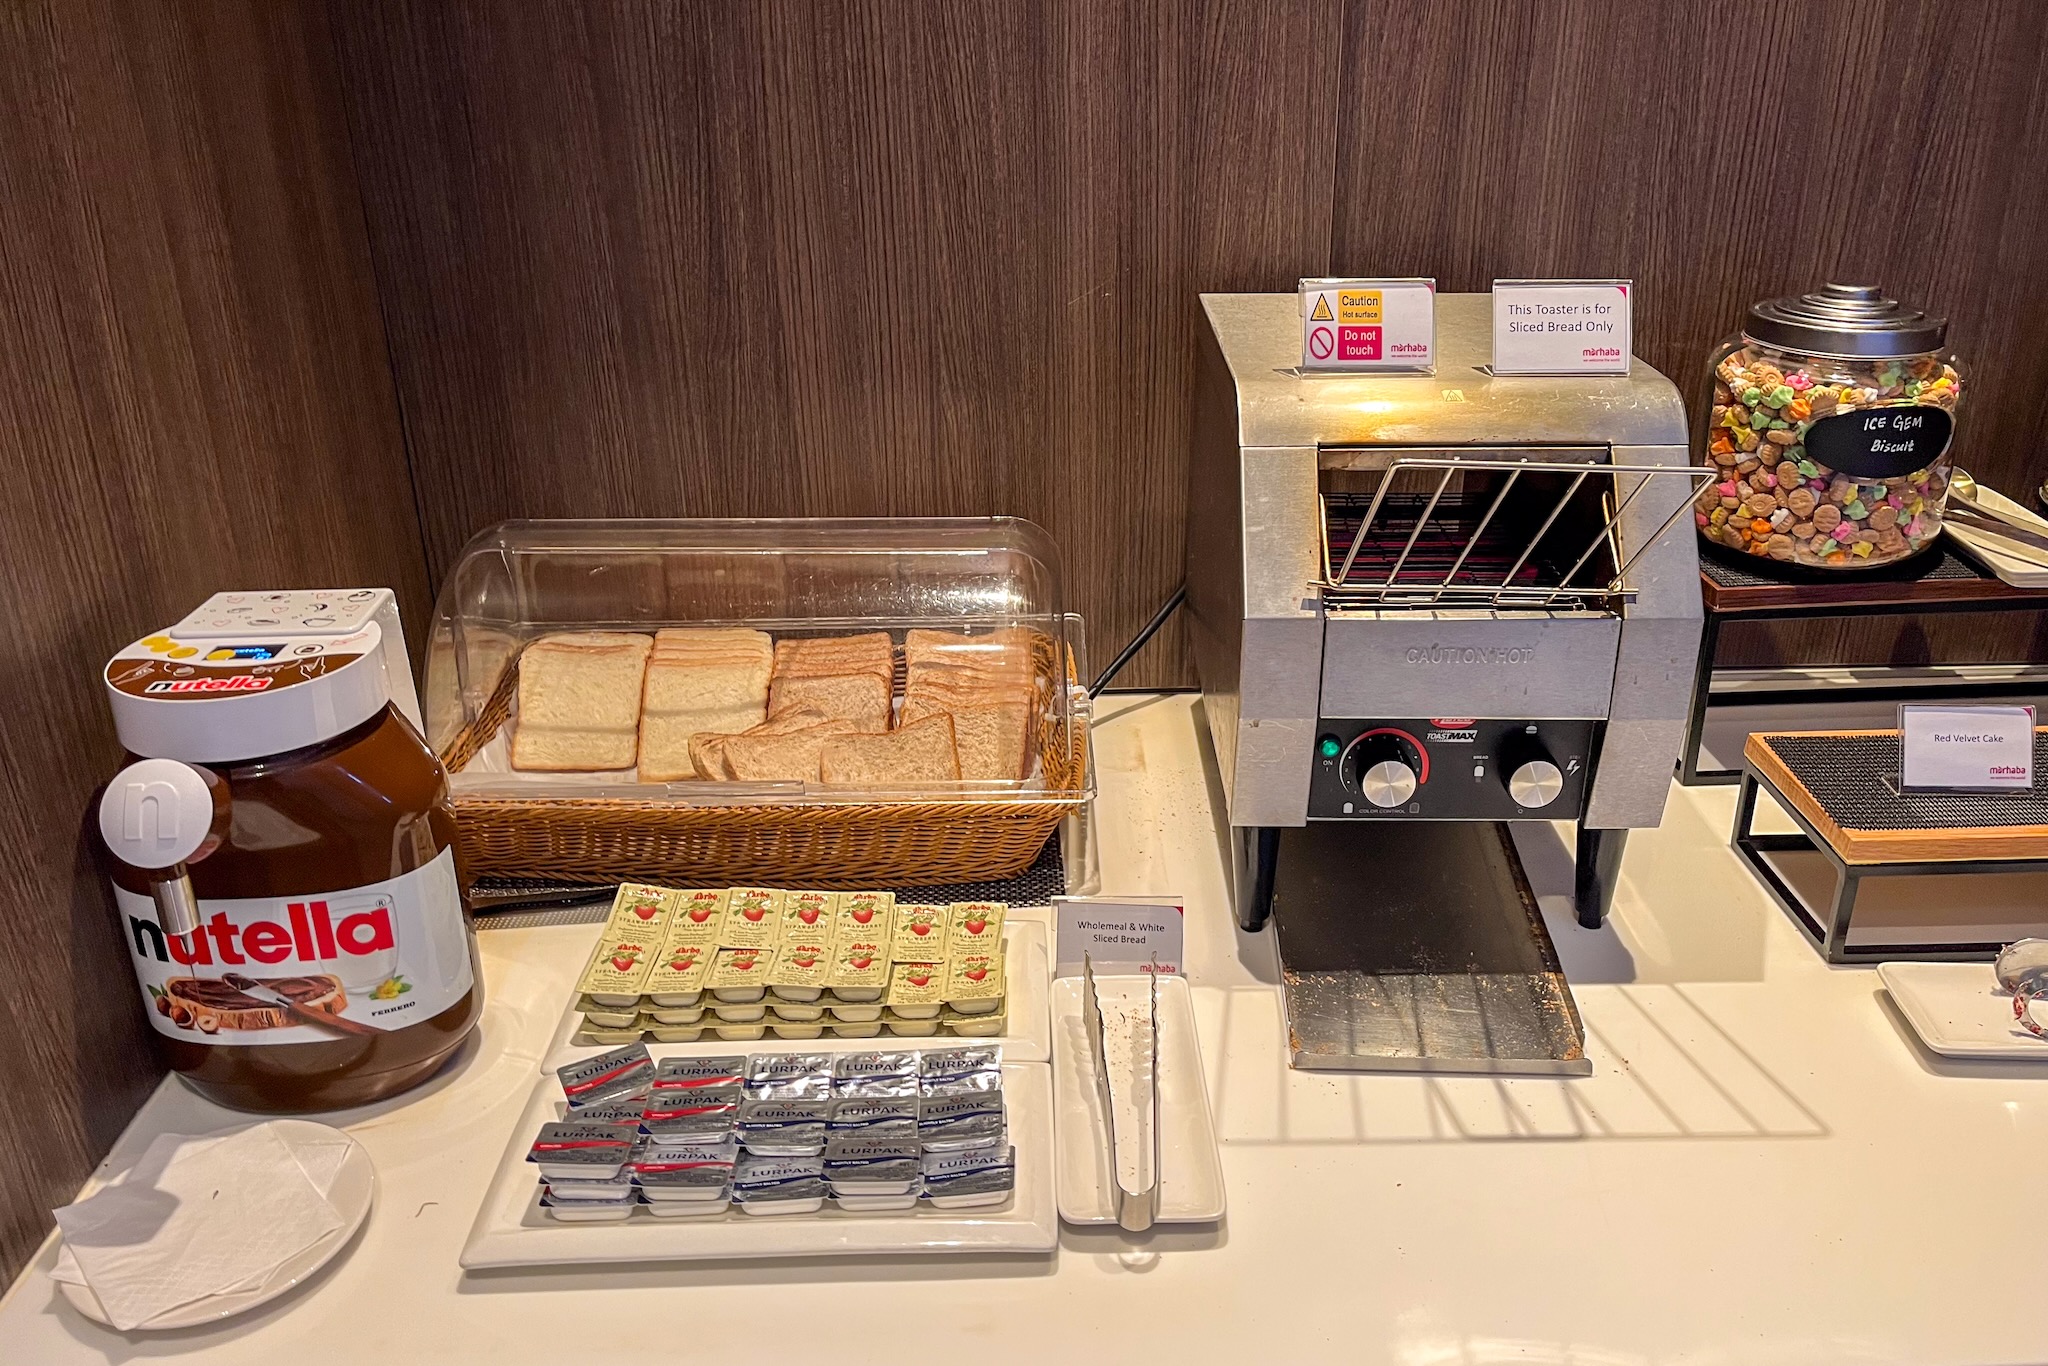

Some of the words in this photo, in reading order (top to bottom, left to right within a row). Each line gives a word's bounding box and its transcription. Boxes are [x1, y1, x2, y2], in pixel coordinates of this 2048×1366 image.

[1341, 295, 1379, 306] Caution
[1355, 310, 1378, 319] surface
[1508, 304, 1532, 315] This
[1535, 304, 1579, 315] Toaster
[1582, 303, 1591, 315] is
[1595, 303, 1612, 314] for
[1509, 321, 1544, 333] Sliced
[1548, 321, 1582, 332] Bread
[1586, 320, 1614, 334] Only
[1344, 329, 1358, 341] Do
[1360, 330, 1376, 341] not
[1346, 345, 1374, 355] touch
[1863, 417, 1887, 431] ICE
[1892, 415, 1923, 432] GEM
[1870, 439, 1915, 453] Biscuit
[1406, 647, 1488, 664] CAUTION
[1495, 647, 1534, 664] HOT
[147, 676, 272, 692] nutella
[1427, 732, 1476, 740] TOASTMAX
[1934, 734, 1951, 742] Red
[1953, 734, 1980, 743] Velvet
[1983, 734, 2004, 743] Cake
[1077, 921, 1127, 931] Wholemeal
[1129, 923, 1137, 931] &
[1139, 923, 1165, 932] White
[128, 901, 394, 965] nutella
[1093, 934, 1119, 943] Sliced
[1121, 935, 1147, 944] Bread
[1140, 963, 1176, 973] mahaba
[371, 1001, 416, 1017] FERRERO
[575, 1055, 635, 1079] LURPAK
[761, 1065, 817, 1073] LURPAK
[846, 1063, 902, 1071] LURPAK
[928, 1059, 984, 1070] LURPAK
[673, 1067, 730, 1075] LURPAK
[664, 1096, 723, 1106] LURPAK
[842, 1106, 900, 1115] LURPAK
[927, 1102, 986, 1113] LURPAK
[553, 1131, 616, 1139] LURPAK
[939, 1157, 999, 1168] LURPAK
[752, 1167, 814, 1177] LURPAK
